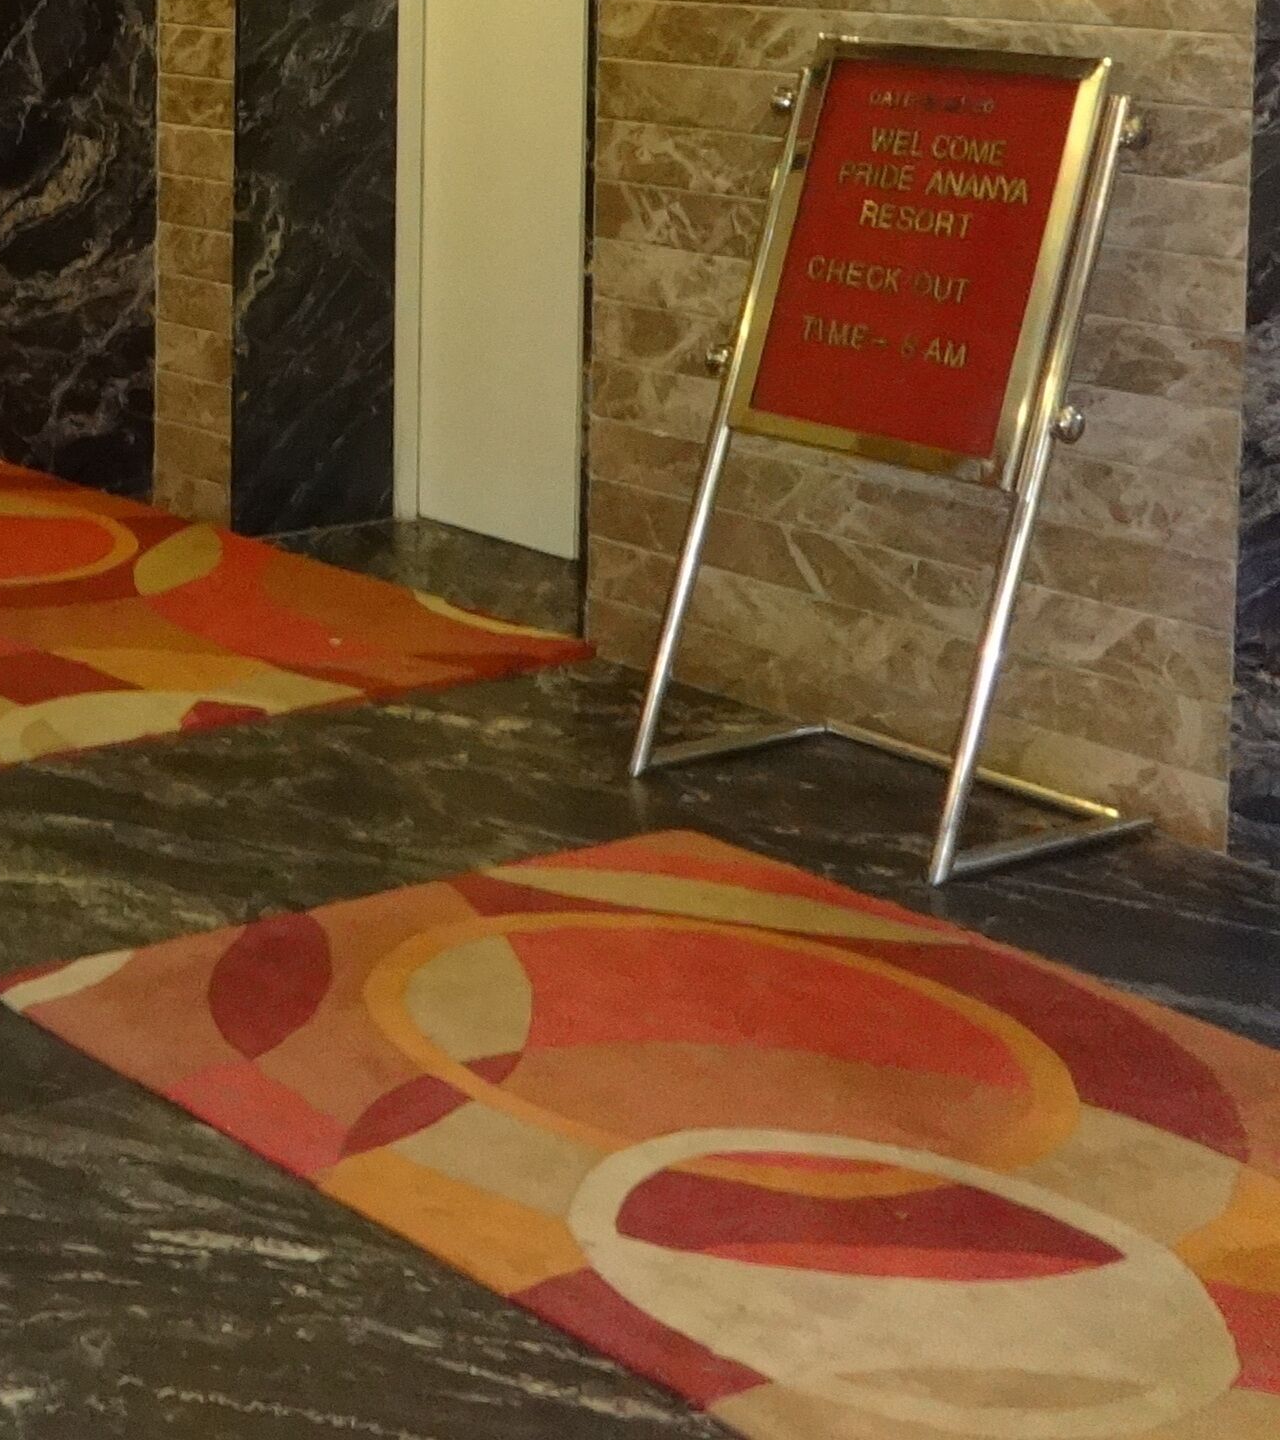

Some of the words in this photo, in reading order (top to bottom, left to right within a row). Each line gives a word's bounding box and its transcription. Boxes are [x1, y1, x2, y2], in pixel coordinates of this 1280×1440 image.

[839, 162, 916, 192] PRIDE
[925, 170, 1030, 206] ANANYA
[859, 199, 974, 240] RESORT
[808, 255, 903, 293] CHECK
[913, 271, 971, 304] OUT
[924, 337, 968, 368] AM
